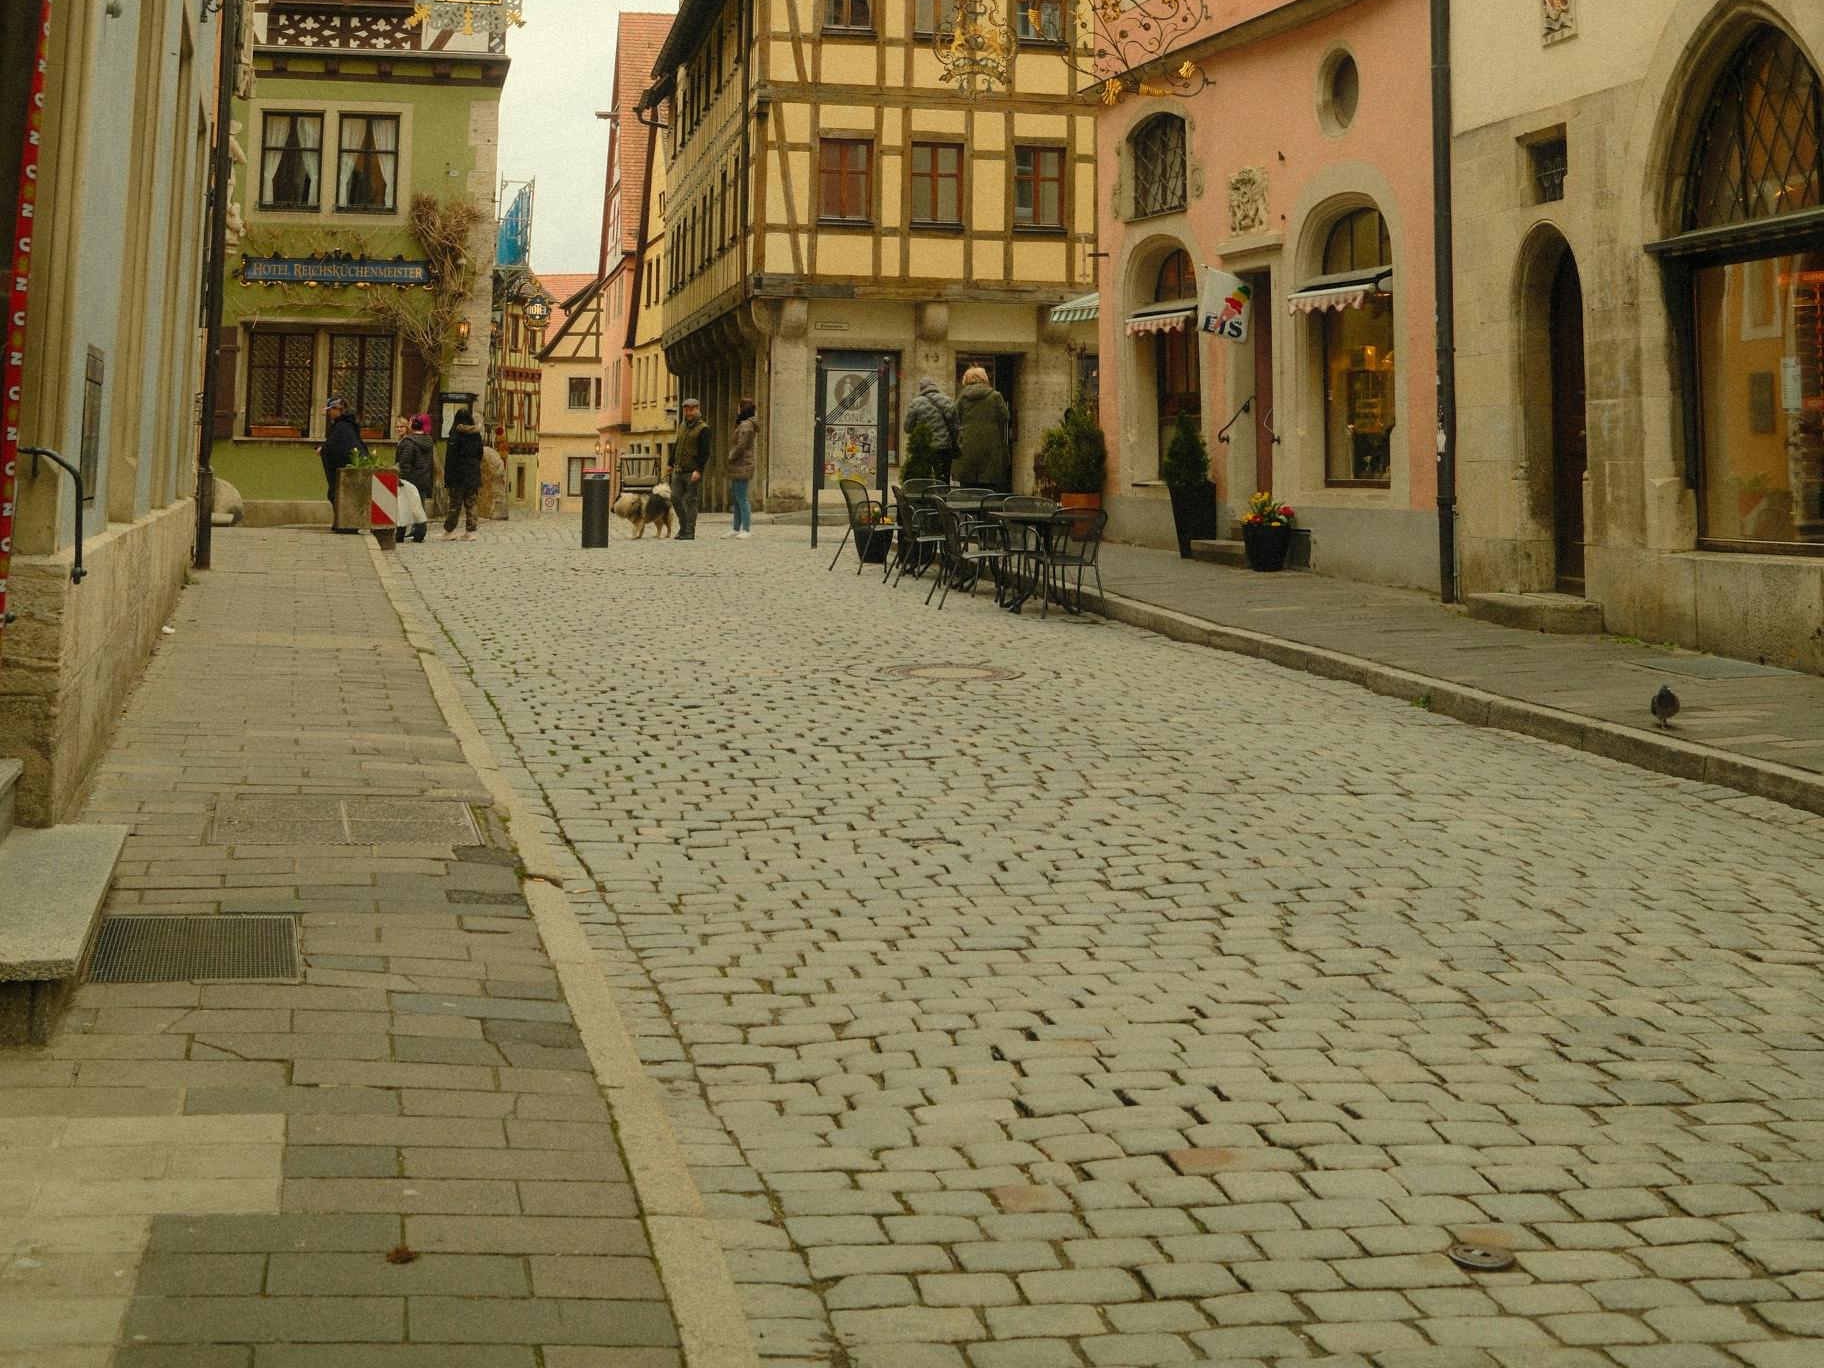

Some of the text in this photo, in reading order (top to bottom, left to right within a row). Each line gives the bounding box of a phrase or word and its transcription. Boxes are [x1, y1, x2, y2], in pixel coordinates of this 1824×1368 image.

[253, 262, 290, 276] HOTEL
[526, 303, 548, 315] HOTEL
[1203, 314, 1242, 339] EIS
[838, 412, 866, 423] ZONE
